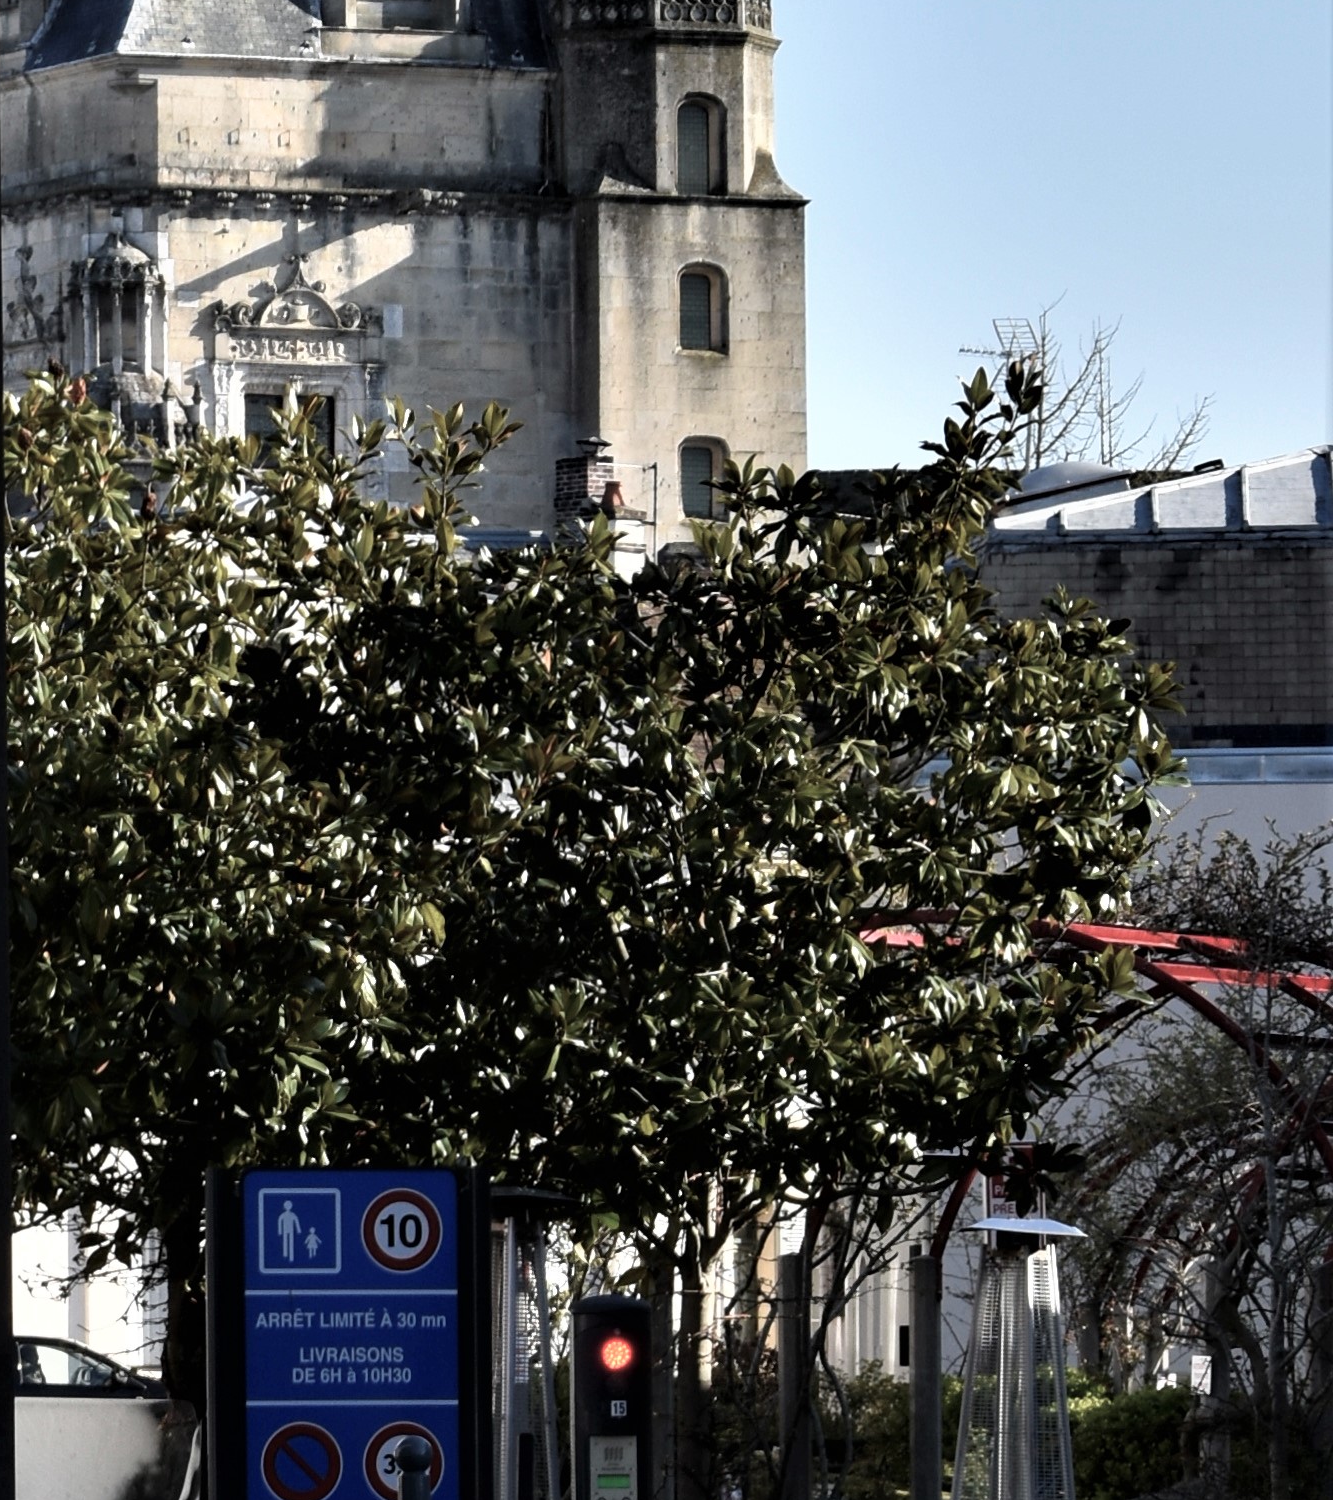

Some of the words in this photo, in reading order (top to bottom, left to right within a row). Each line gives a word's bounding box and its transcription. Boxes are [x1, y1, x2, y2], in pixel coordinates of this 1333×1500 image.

[380, 1213, 422, 1249] 10
[255, 1308, 315, 1329] ARRÊT
[319, 1308, 375, 1328] LIMITÉ
[380, 1307, 392, 1328] À
[397, 1312, 416, 1328] 30
[421, 1314, 447, 1328] mn
[299, 1346, 404, 1364] LIVRAISONS
[292, 1367, 316, 1384] DE
[320, 1367, 342, 1384] 6H
[347, 1367, 357, 1383] à
[362, 1367, 412, 1384] 10H30
[613, 1402, 625, 1415] 15
